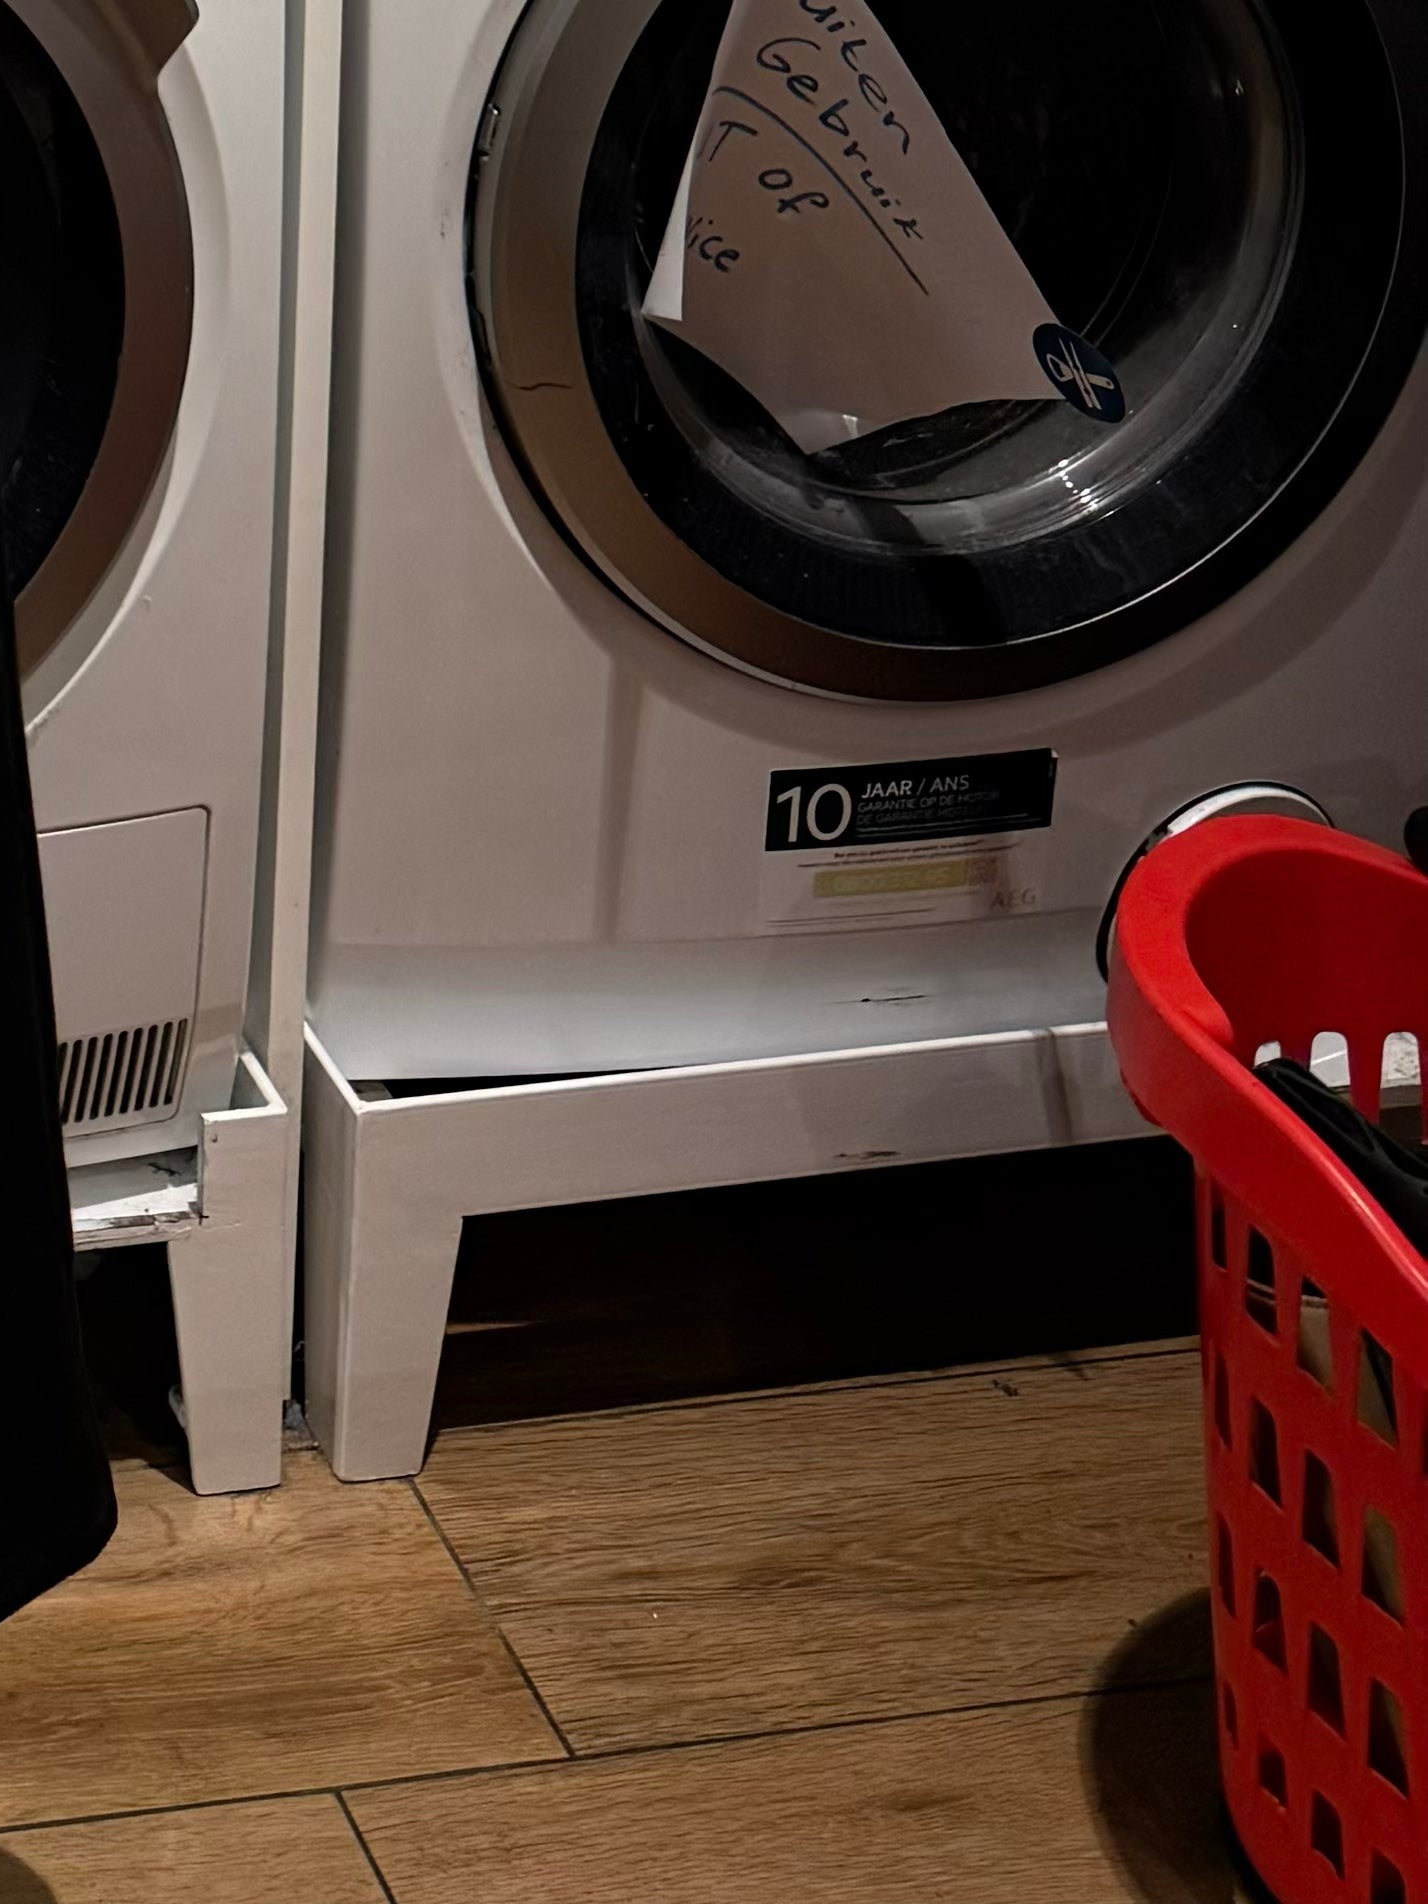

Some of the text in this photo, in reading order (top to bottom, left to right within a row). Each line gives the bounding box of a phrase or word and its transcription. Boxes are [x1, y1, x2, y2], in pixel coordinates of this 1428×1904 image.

[756, 37, 923, 240] Gebruik
[775, 783, 853, 844] 10
[861, 779, 913, 799] JAAR
[929, 774, 971, 793] ANS
